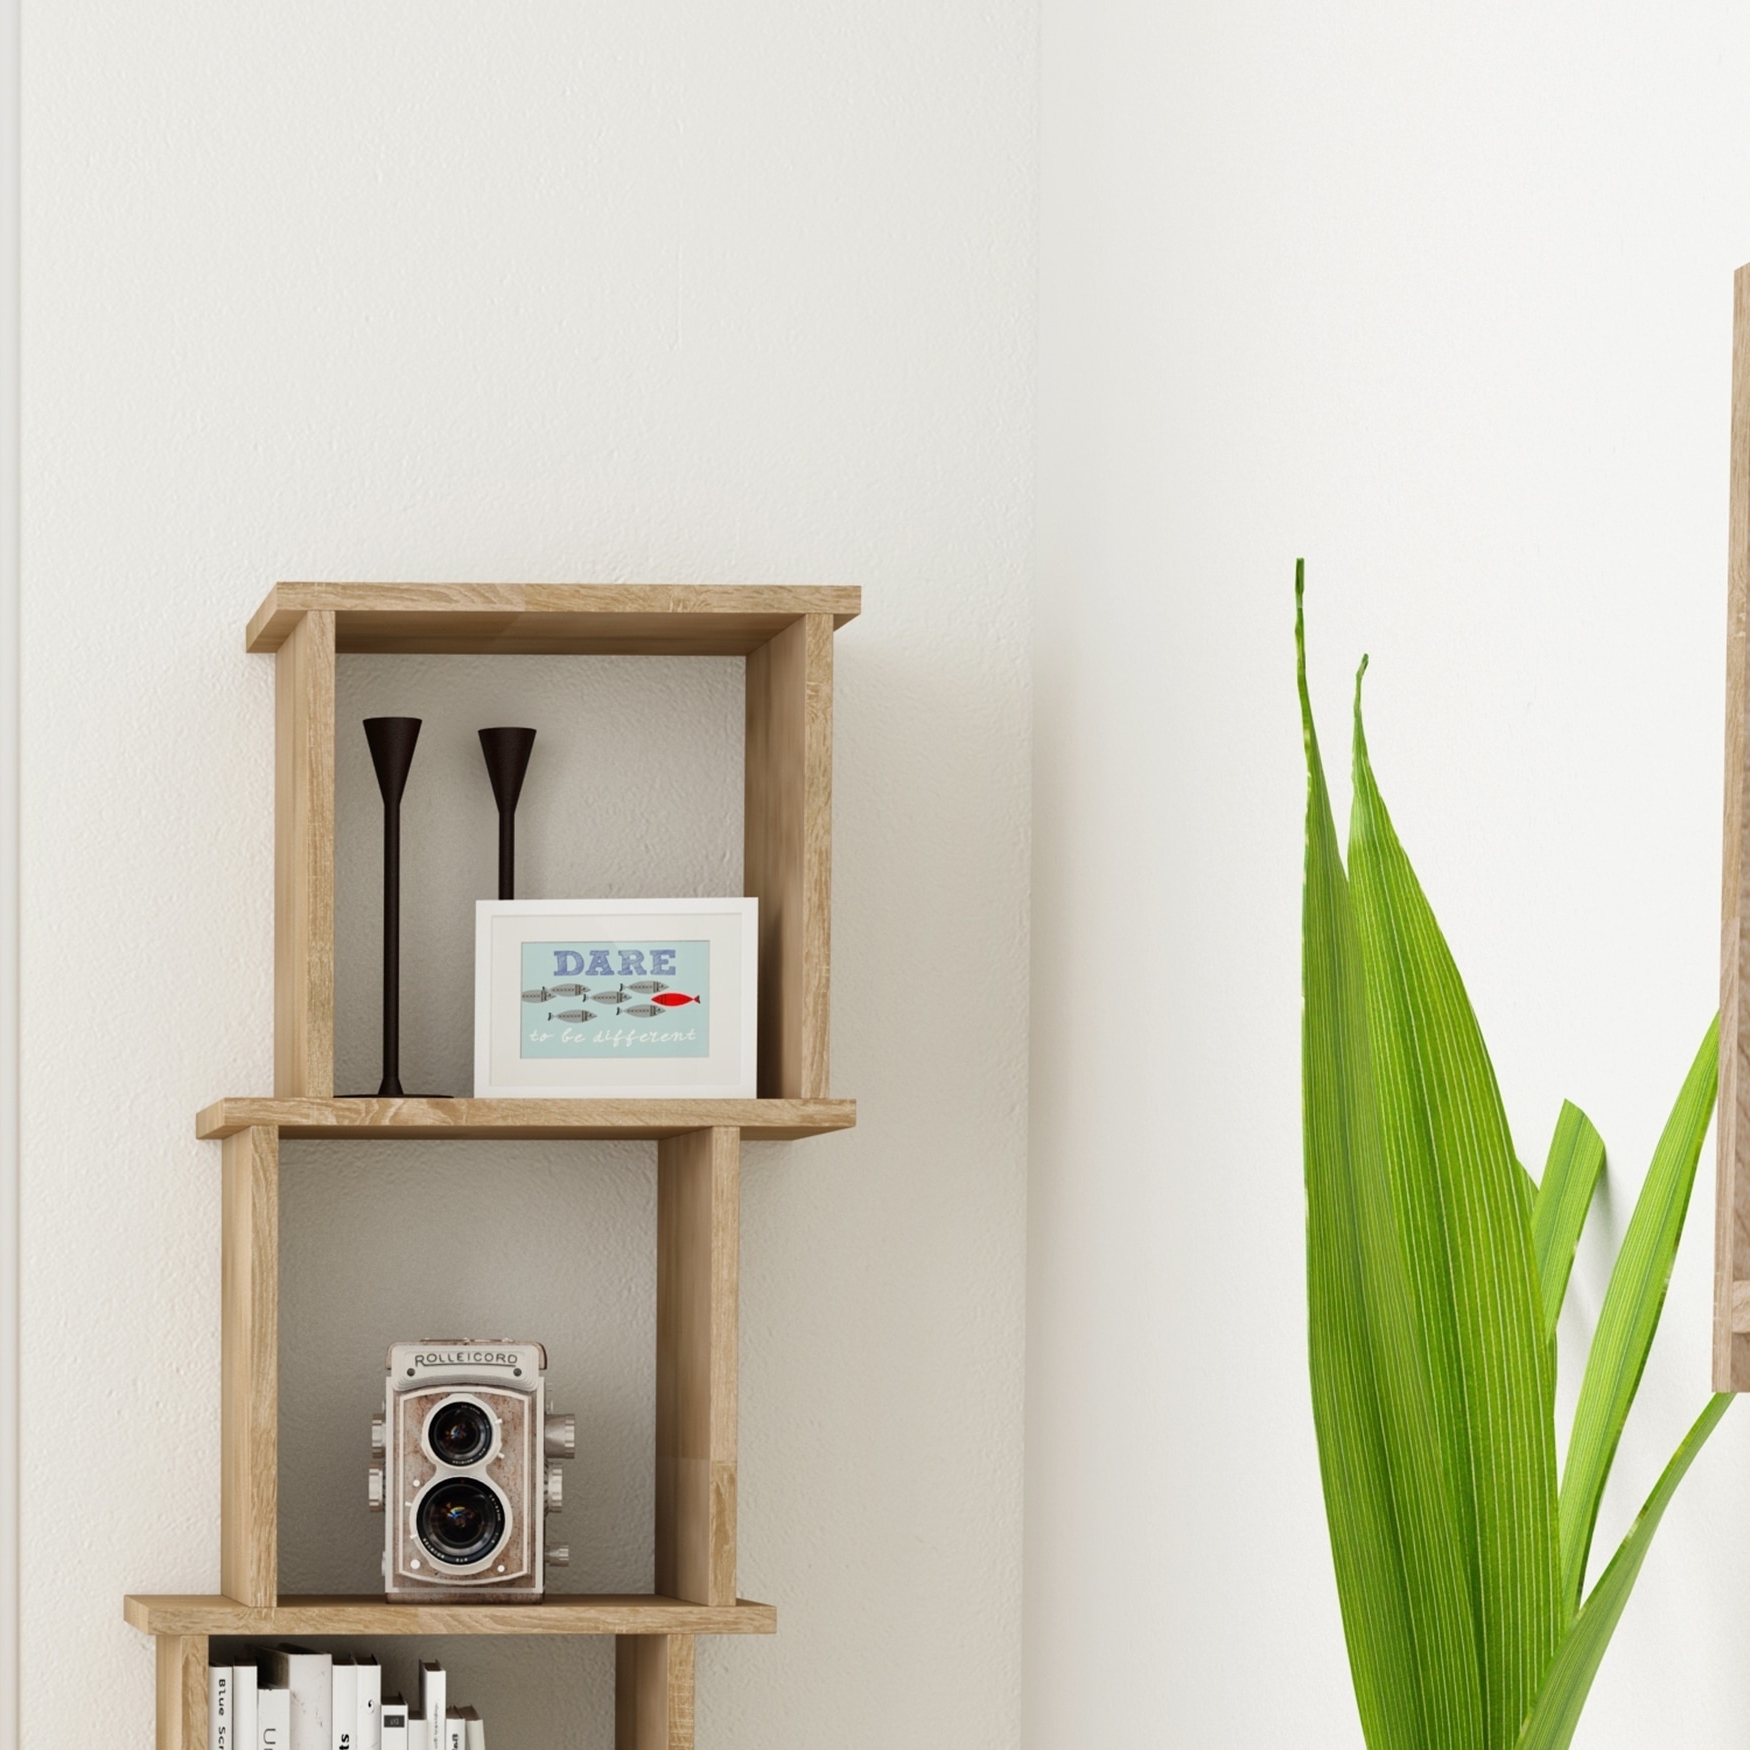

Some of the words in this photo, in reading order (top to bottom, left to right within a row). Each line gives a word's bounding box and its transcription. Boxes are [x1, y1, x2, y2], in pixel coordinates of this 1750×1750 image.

[553, 950, 676, 976] DARE
[529, 1029, 554, 1042] to
[561, 1027, 586, 1043] be
[592, 1027, 697, 1048] different
[414, 1352, 518, 1368] ROLLEICORD
[217, 1678, 227, 1716] Blue
